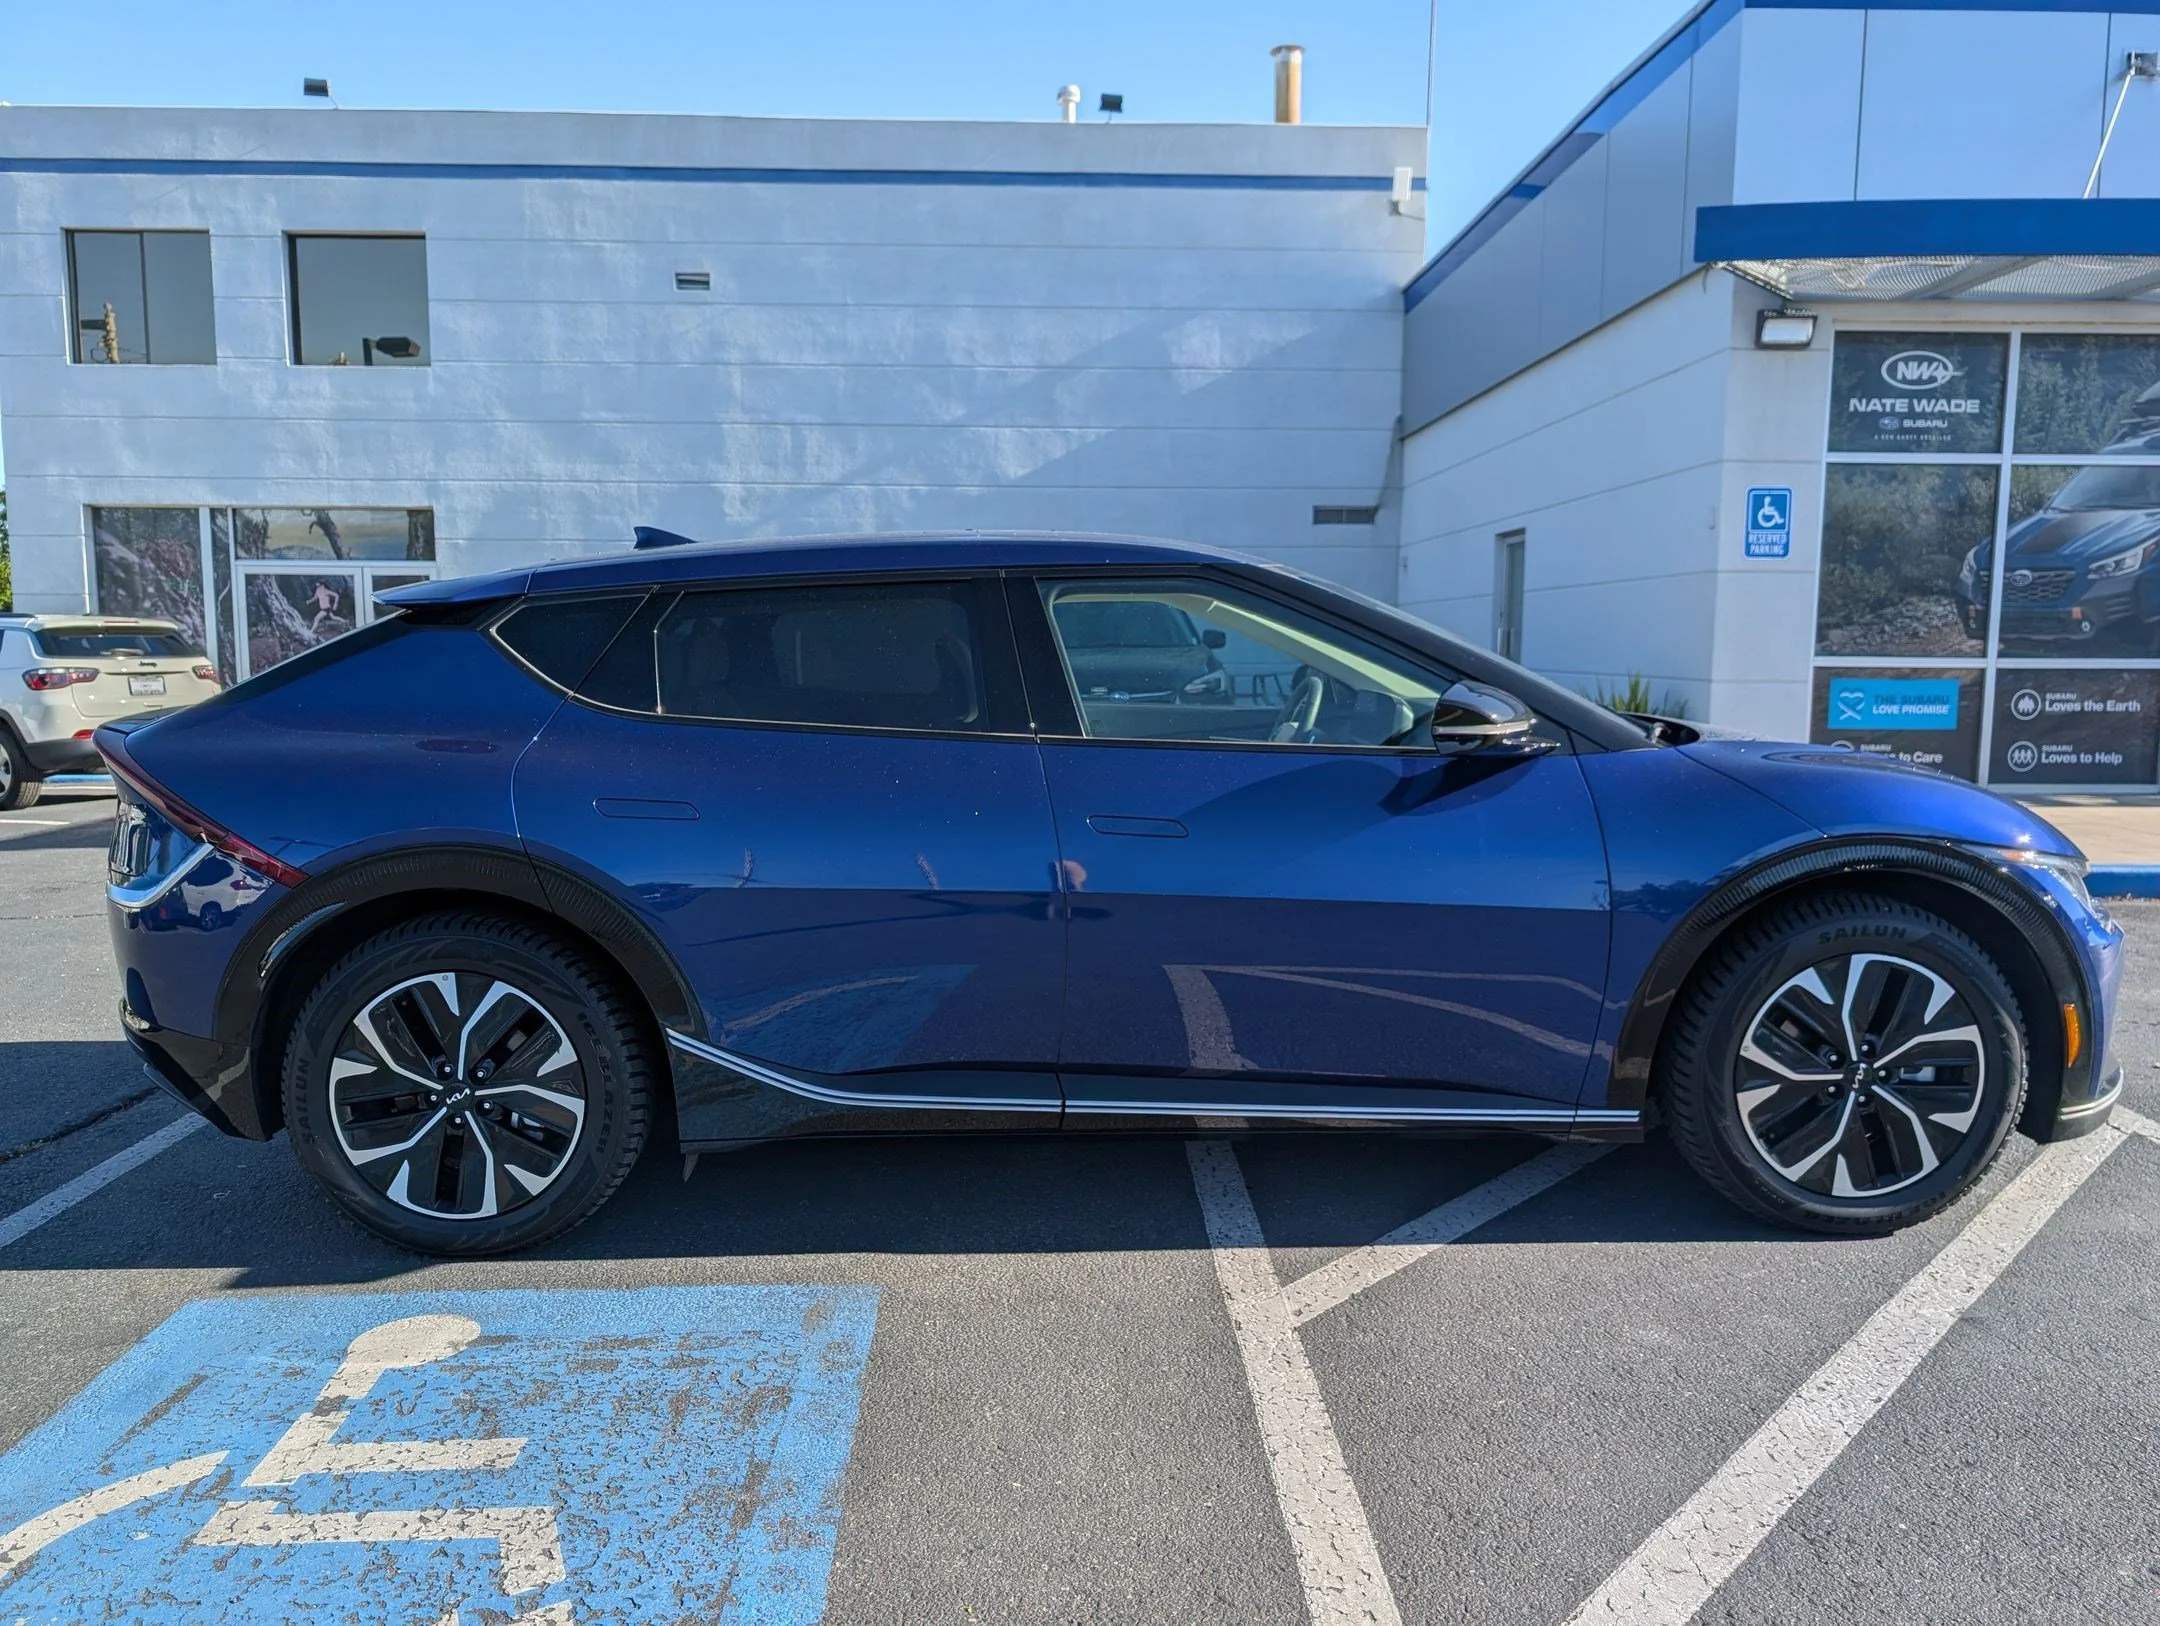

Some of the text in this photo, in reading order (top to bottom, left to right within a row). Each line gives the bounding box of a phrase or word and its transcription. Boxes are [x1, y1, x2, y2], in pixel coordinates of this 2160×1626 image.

[1848, 398, 1980, 414] NATE WADE
[1902, 418, 1949, 429] SUBARU
[1748, 533, 1787, 545] RESERVED
[1750, 545, 1784, 556] PARKING
[1875, 694, 1950, 705] THE SUBARU
[2045, 692, 2077, 701] SUBARU
[1872, 704, 1949, 715] LOVE PROMISE
[2045, 700, 2141, 713] Loves the Earth
[1860, 743, 1892, 752] SUBARU
[2041, 744, 2073, 752] SUBARU
[1899, 751, 1912, 762] to
[1913, 751, 1943, 763] Care
[2041, 752, 2123, 766] Loves to Help
[1818, 925, 1907, 945] SAILUN
[296, 1058, 315, 1145] SAILUN
